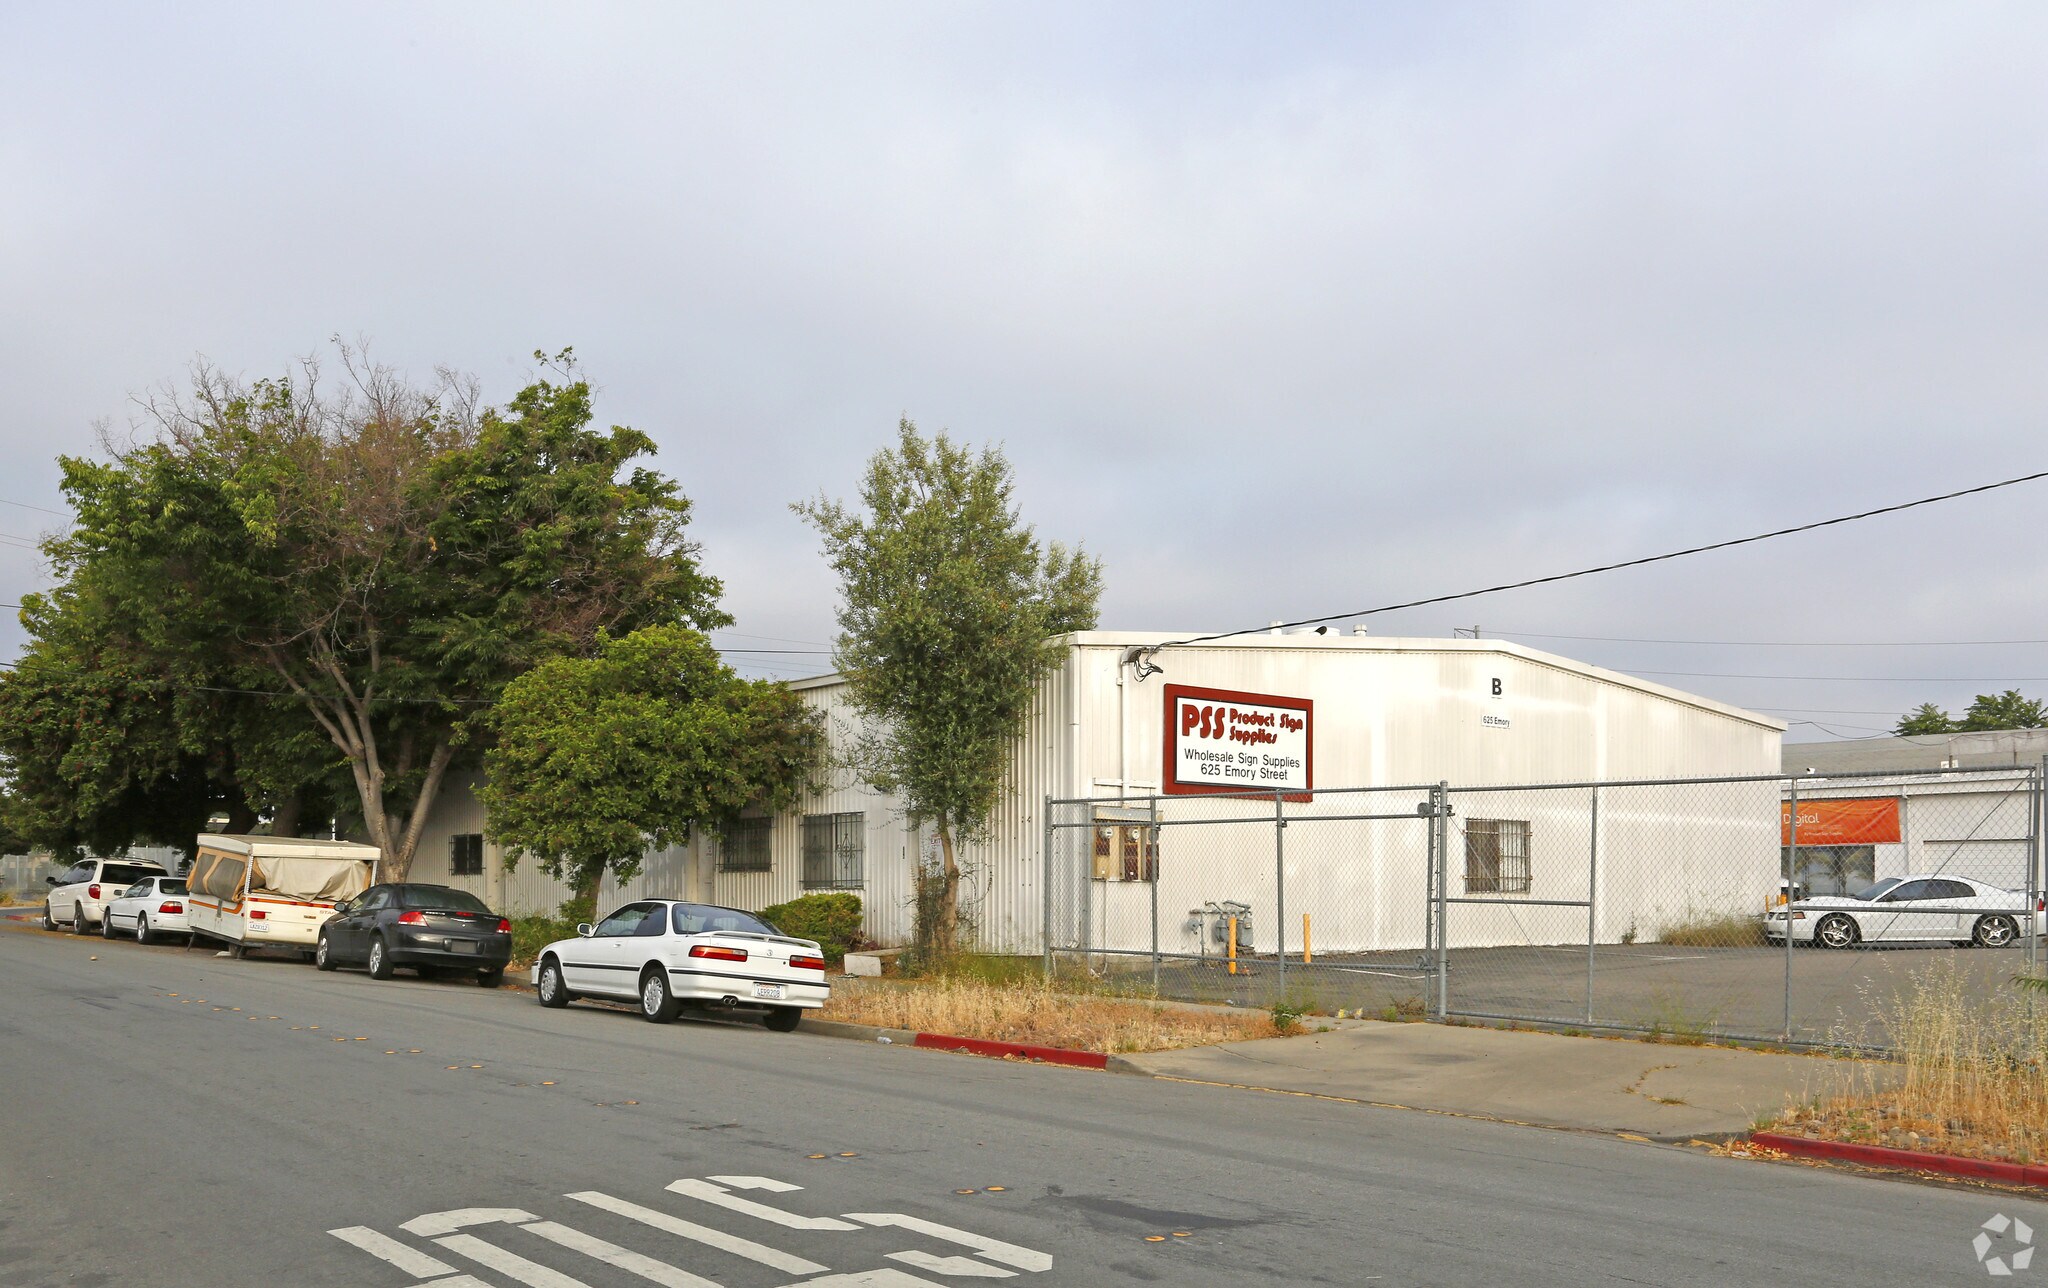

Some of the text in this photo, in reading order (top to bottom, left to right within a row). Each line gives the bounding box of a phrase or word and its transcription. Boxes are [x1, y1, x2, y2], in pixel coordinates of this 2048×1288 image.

[1492, 677, 1502, 695] B
[1181, 704, 1226, 739] PSS
[1229, 708, 1303, 733] Product Sign
[1483, 715, 1510, 727] 625 Emory
[1229, 726, 1278, 746] Supplies
[1184, 748, 1300, 769] Wholesale Sign Supplies
[1200, 764, 1288, 780] 625 Emory Street
[1783, 813, 1820, 827] Dgital
